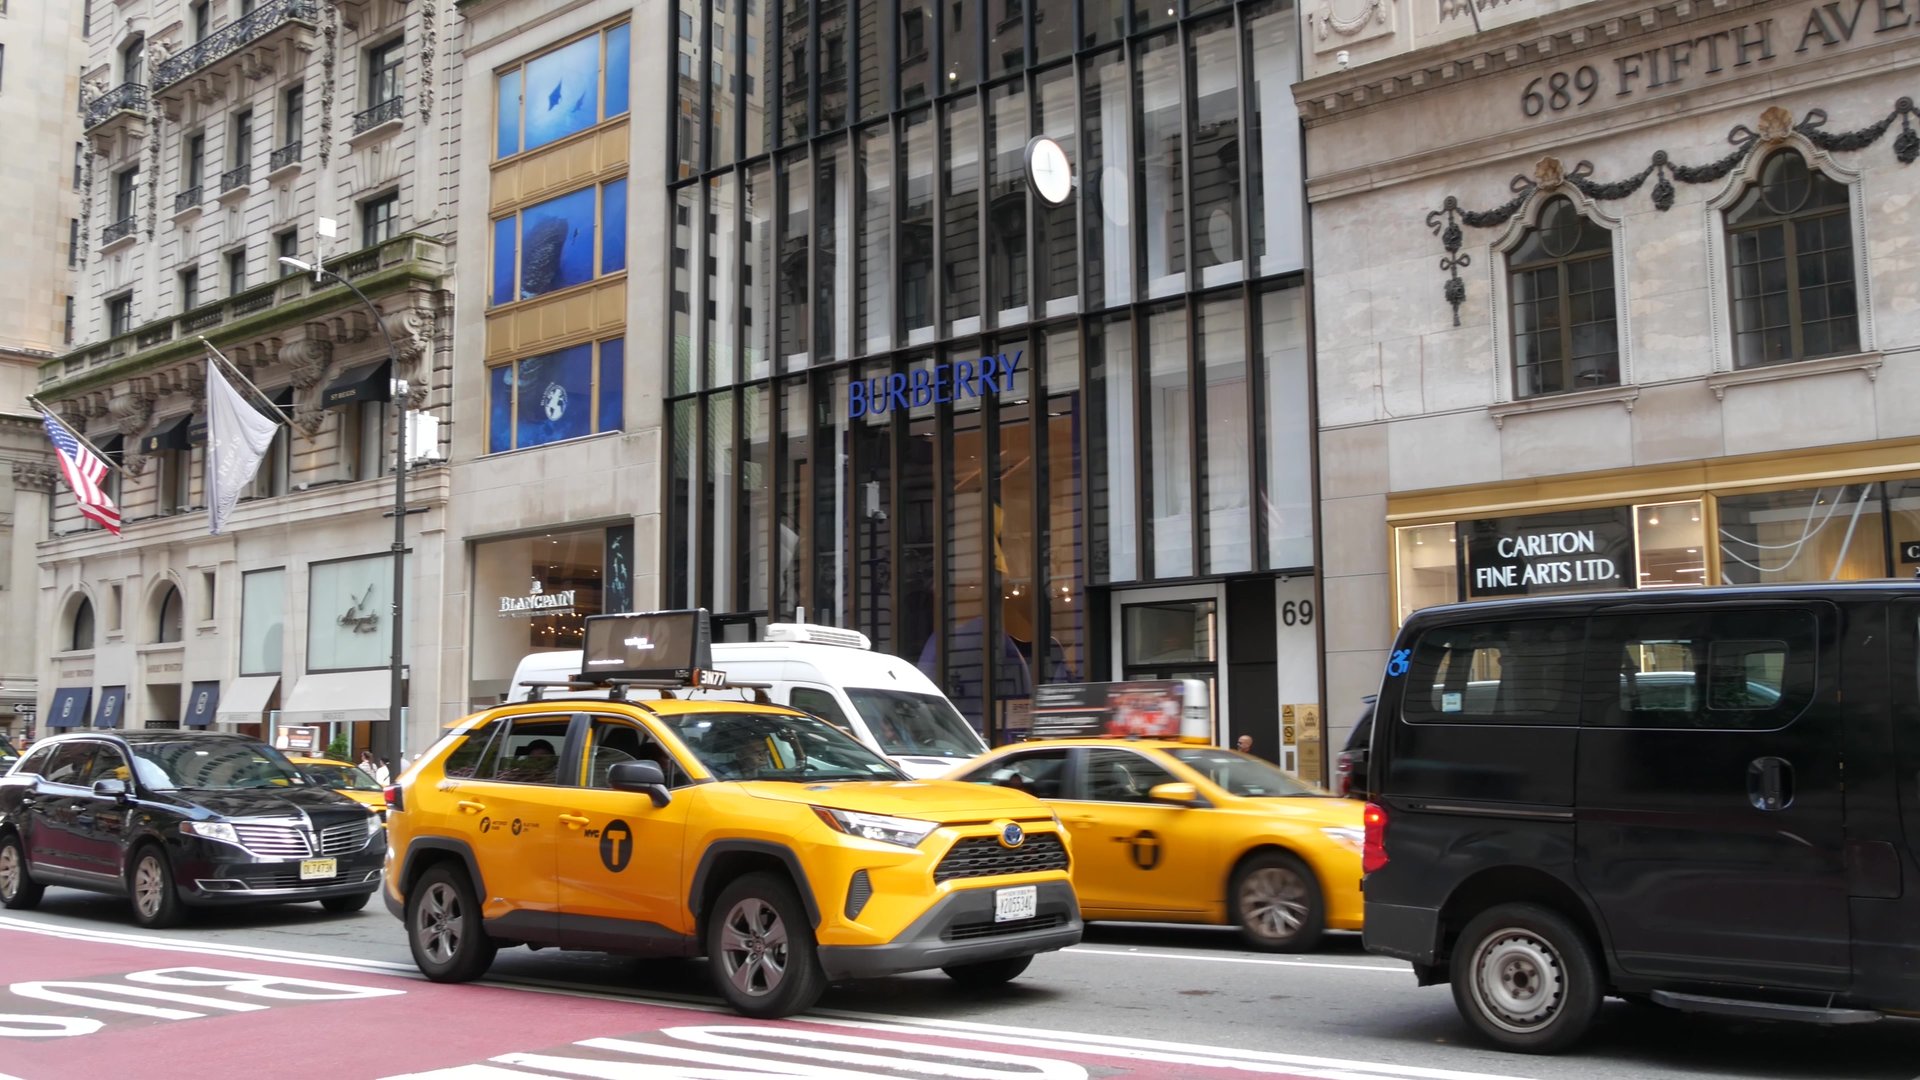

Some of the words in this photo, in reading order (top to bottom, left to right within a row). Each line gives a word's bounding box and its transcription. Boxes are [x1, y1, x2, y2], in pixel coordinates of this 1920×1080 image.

[1520, 65, 1599, 118] 689
[1613, 18, 1775, 97] FIFTH
[1794, 0, 1920, 53] AVE
[848, 350, 1024, 420] BURBERRY
[1497, 530, 1595, 558] CARLTON
[1476, 565, 1518, 589] FINE
[1521, 561, 1573, 586] ARTS
[1576, 558, 1621, 582] LTD.
[499, 589, 576, 612] BLANCPAIN
[1282, 599, 1314, 627] 69
[701, 670, 725, 686] 3N77
